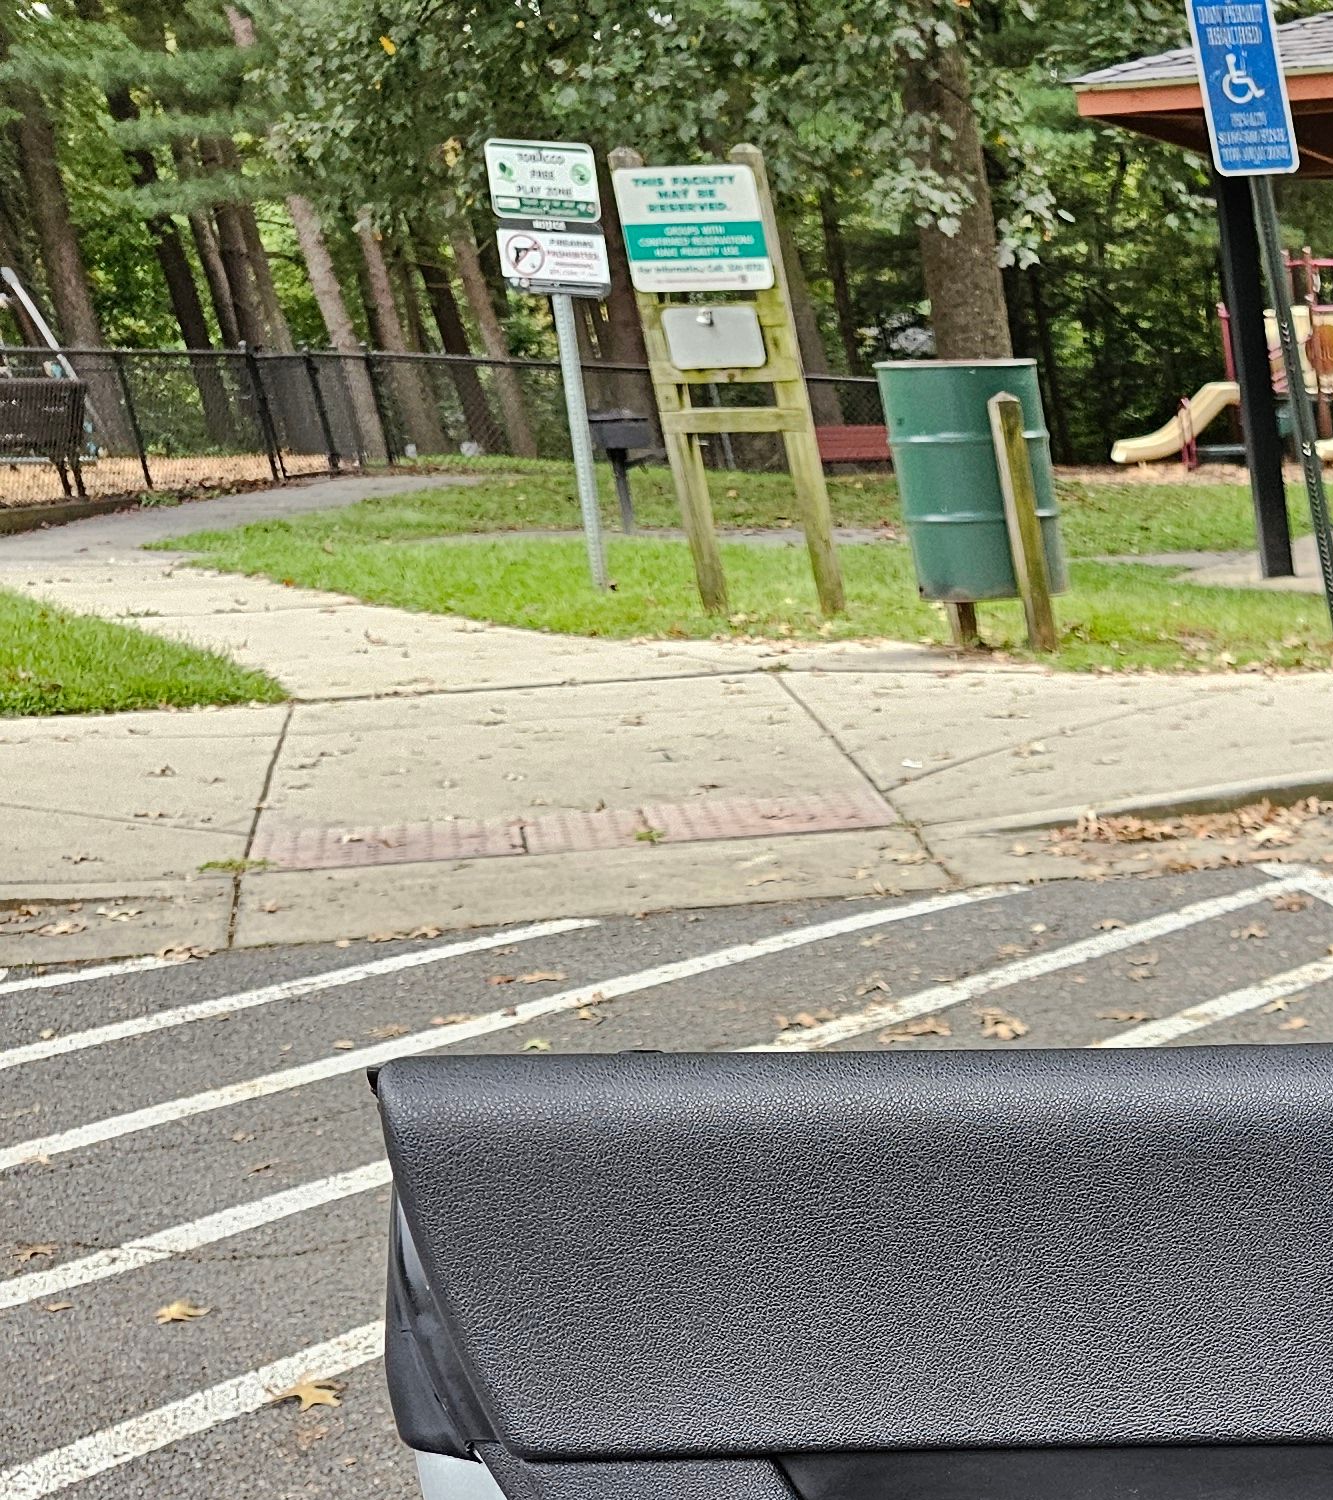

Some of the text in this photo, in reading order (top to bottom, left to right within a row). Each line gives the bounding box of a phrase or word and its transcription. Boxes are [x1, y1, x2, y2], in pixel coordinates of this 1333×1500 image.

[632, 175, 734, 187] THIS FACILITY
[517, 185, 573, 197] PLAY ZONE
[657, 188, 715, 198] MAY BE
